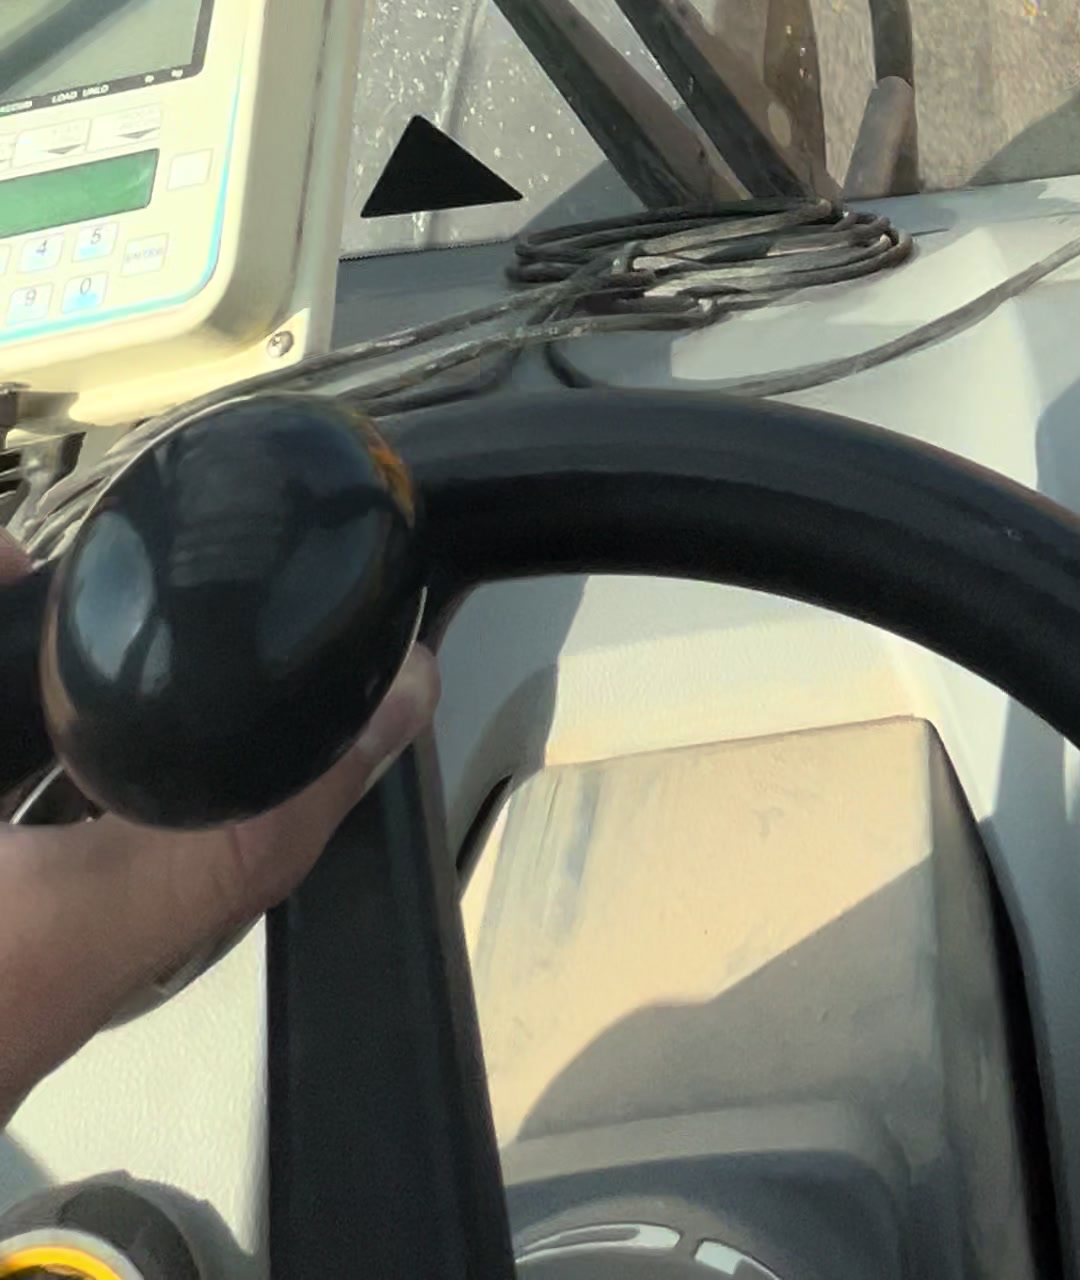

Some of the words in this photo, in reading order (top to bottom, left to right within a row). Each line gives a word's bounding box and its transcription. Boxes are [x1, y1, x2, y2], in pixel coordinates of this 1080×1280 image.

[51, 90, 78, 104] LOAD
[35, 239, 48, 257] 4
[90, 227, 104, 246] 5
[24, 288, 38, 307] 9
[79, 276, 92, 296] 0
